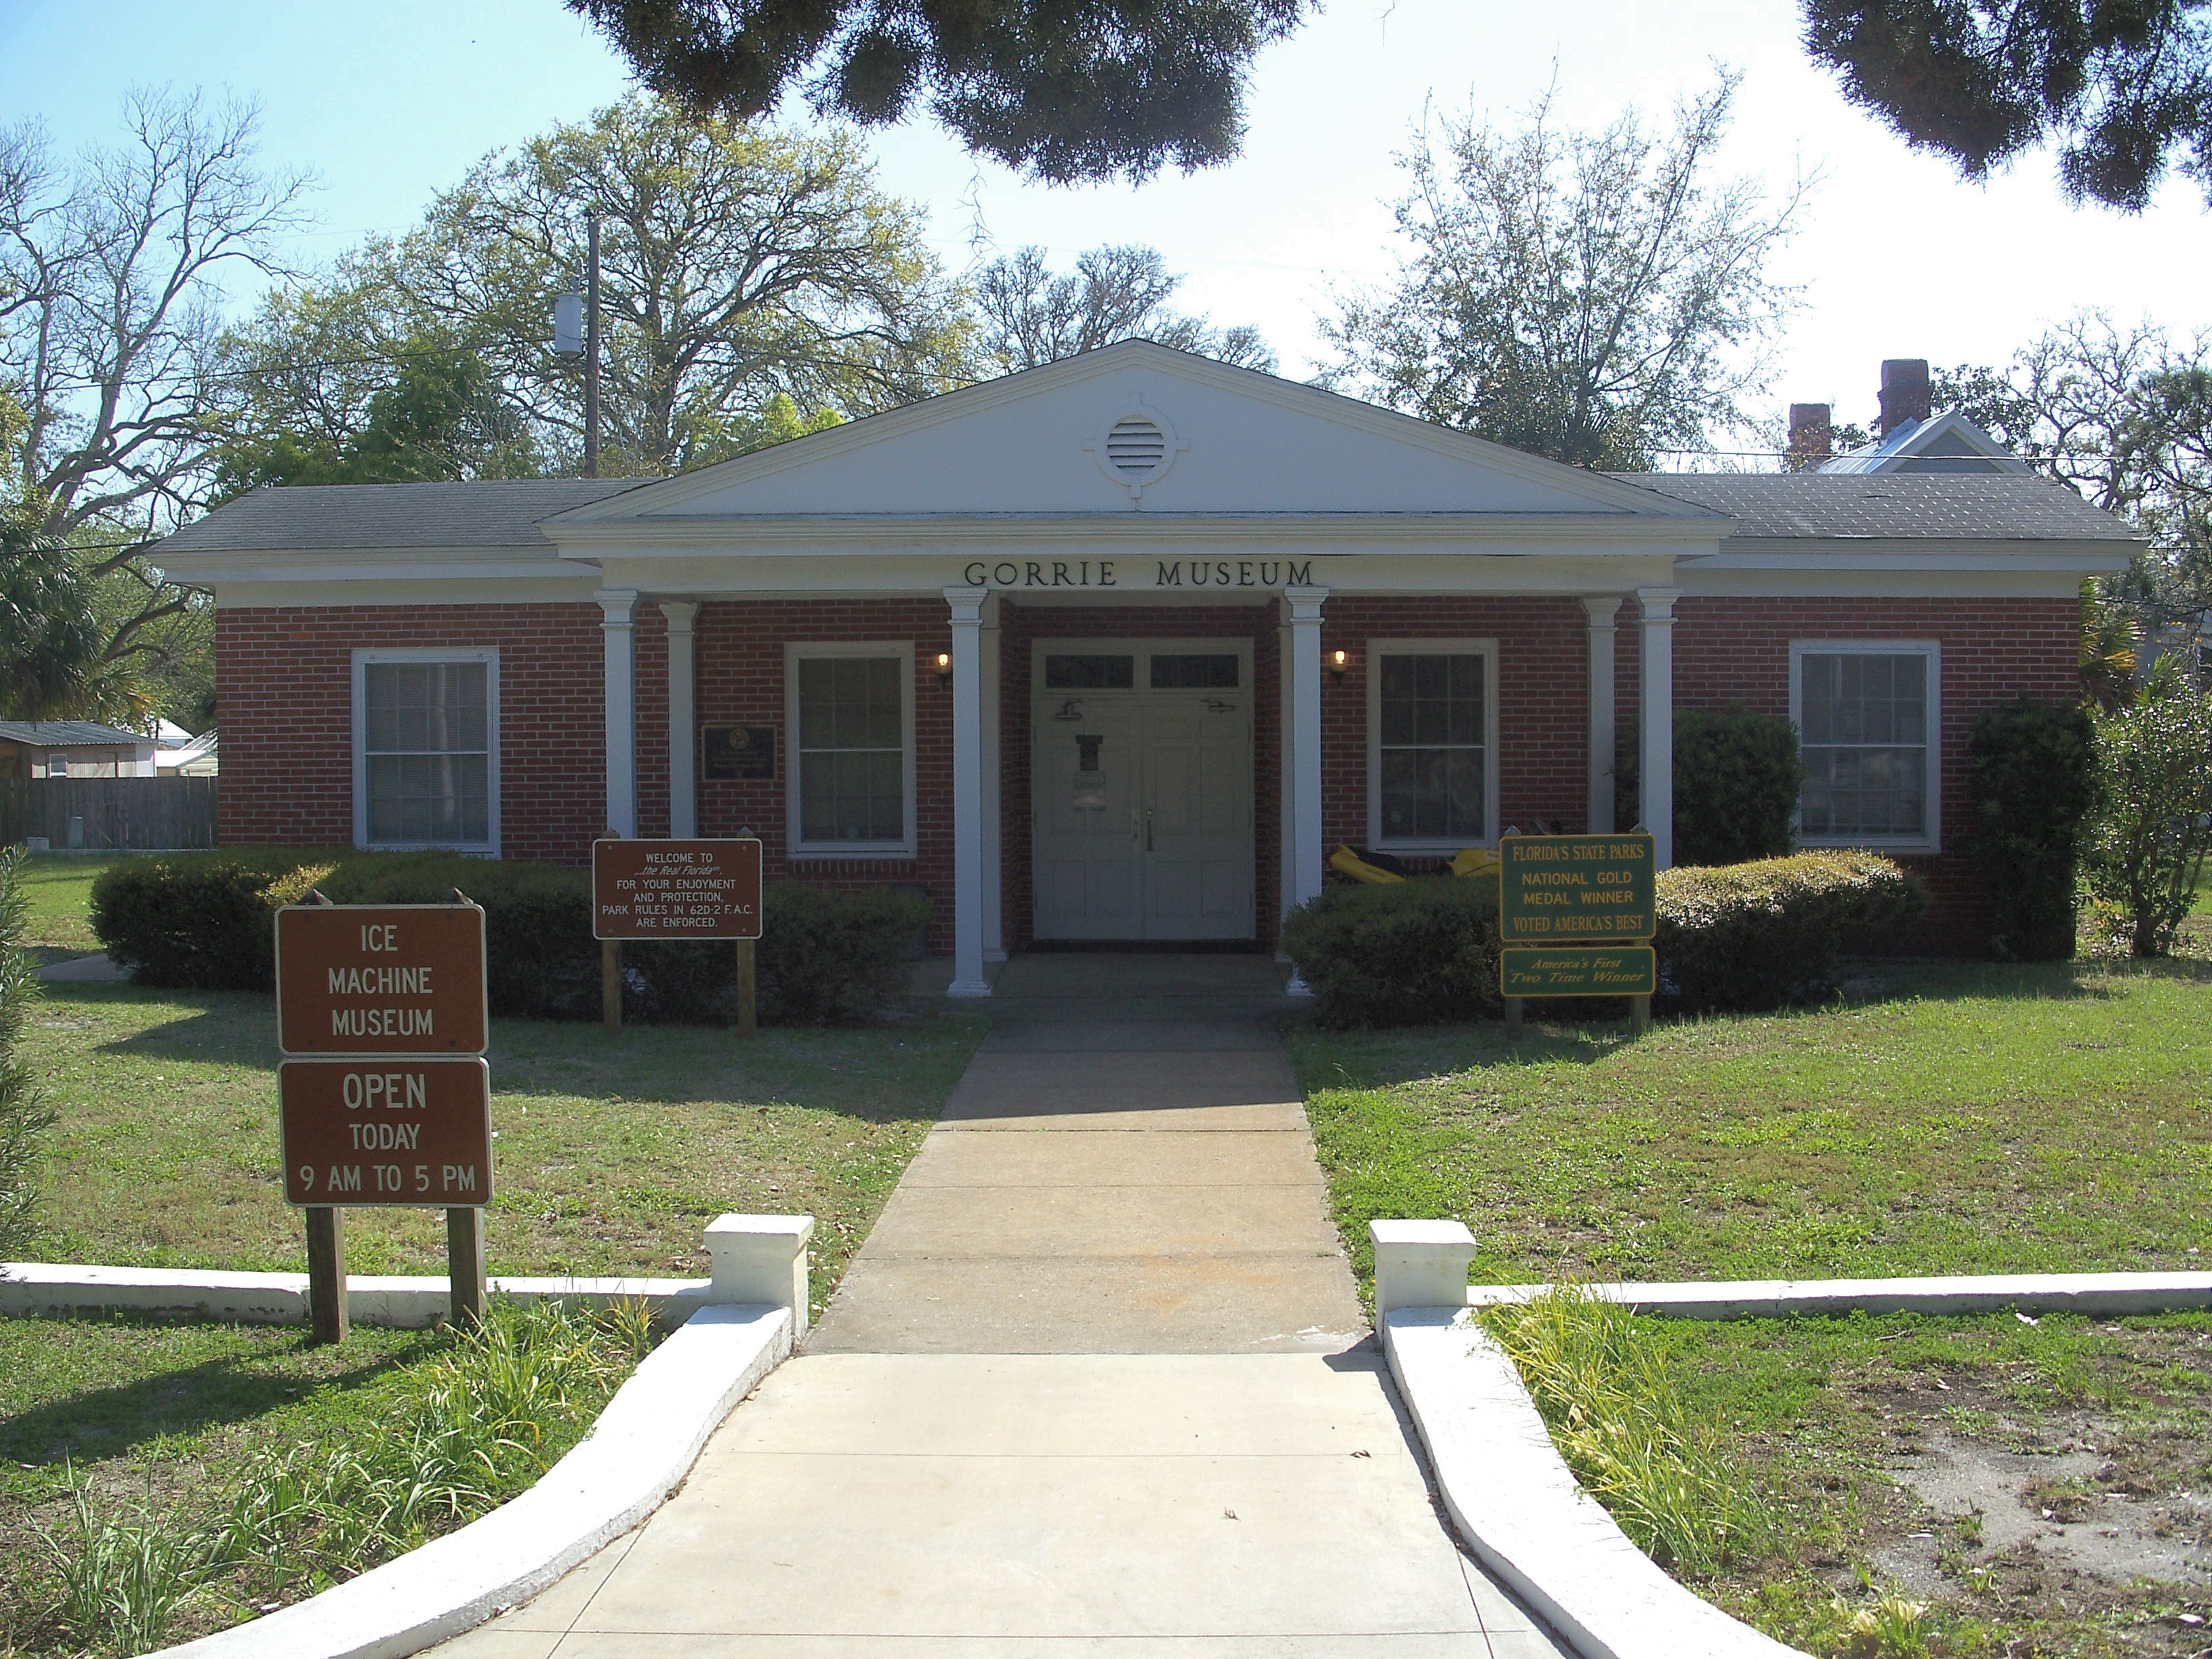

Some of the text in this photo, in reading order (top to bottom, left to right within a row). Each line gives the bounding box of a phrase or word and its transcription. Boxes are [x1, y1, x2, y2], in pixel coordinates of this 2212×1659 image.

[964, 562, 1313, 586] GORRIE MUSEUM
[646, 853, 713, 863] WELCOME TO
[1513, 846, 1569, 861] FLORIDA'S
[1573, 845, 1605, 860] STATE
[1610, 844, 1643, 859] PARKS
[660, 866, 680, 876] Real
[617, 879, 736, 889] FOR YOUR ENJOYMENT
[1522, 872, 1632, 885] NATIONAL GOLD
[634, 893, 723, 903] AND PROTECTION,
[1524, 891, 1633, 905] MEDAL WINNER
[602, 905, 628, 915] PARK
[635, 905, 668, 914] RULES
[674, 905, 684, 914] IN
[690, 905, 720, 914] 62D-2
[636, 918, 718, 927] ARE ENFORCED.
[1513, 915, 1643, 932] VOTED AMERICA'S BEST
[361, 924, 398, 951] ICE
[1532, 958, 1622, 969] America's First
[329, 967, 433, 994] MACHINE
[1510, 972, 1645, 983] Two Time Winner
[332, 1009, 434, 1036] MUSEUM
[343, 1073, 426, 1109] OPEN
[349, 1124, 421, 1151] TODAY
[300, 1164, 475, 1192] 9 AM TO 5 PM
